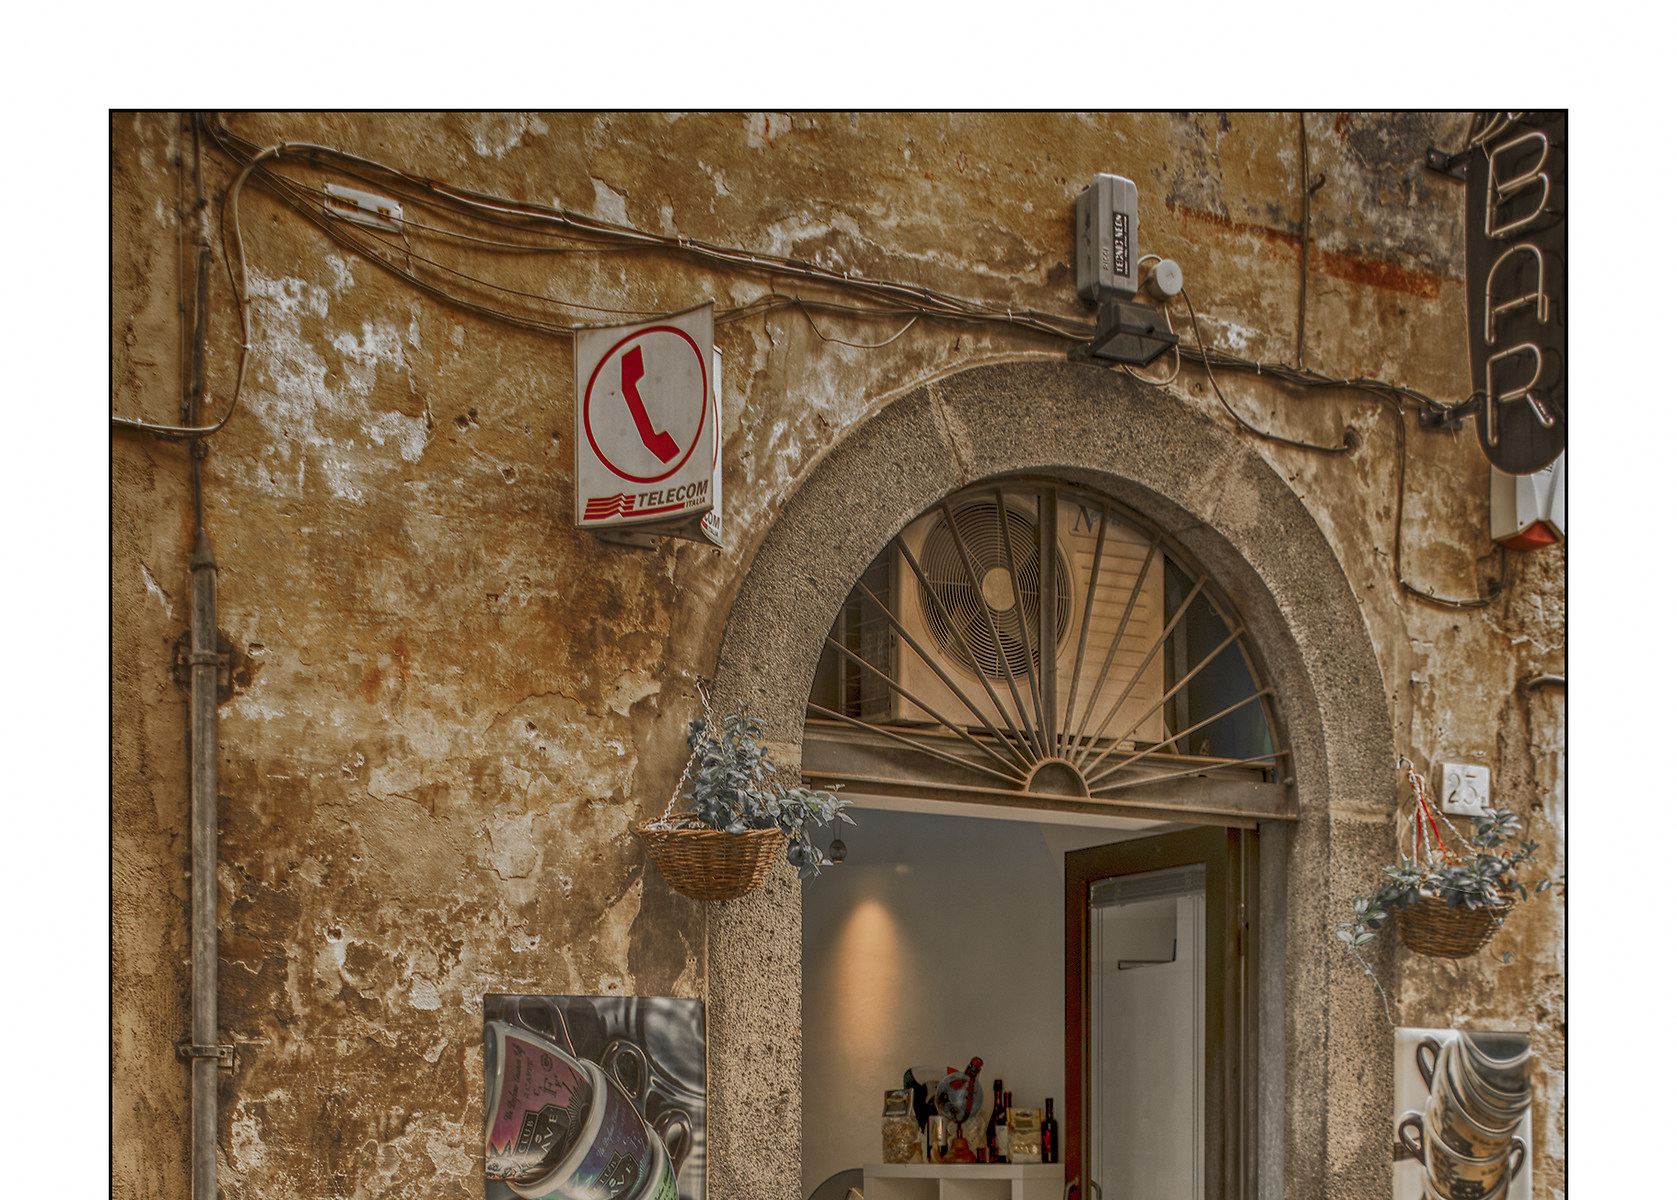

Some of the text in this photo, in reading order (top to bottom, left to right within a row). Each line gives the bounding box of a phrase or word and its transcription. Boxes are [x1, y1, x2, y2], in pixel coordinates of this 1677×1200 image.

[1485, 130, 1555, 447] BAR
[638, 479, 709, 507] TELECOM
[685, 497, 706, 509] ITALIA
[518, 1120, 534, 1153] CLUB
